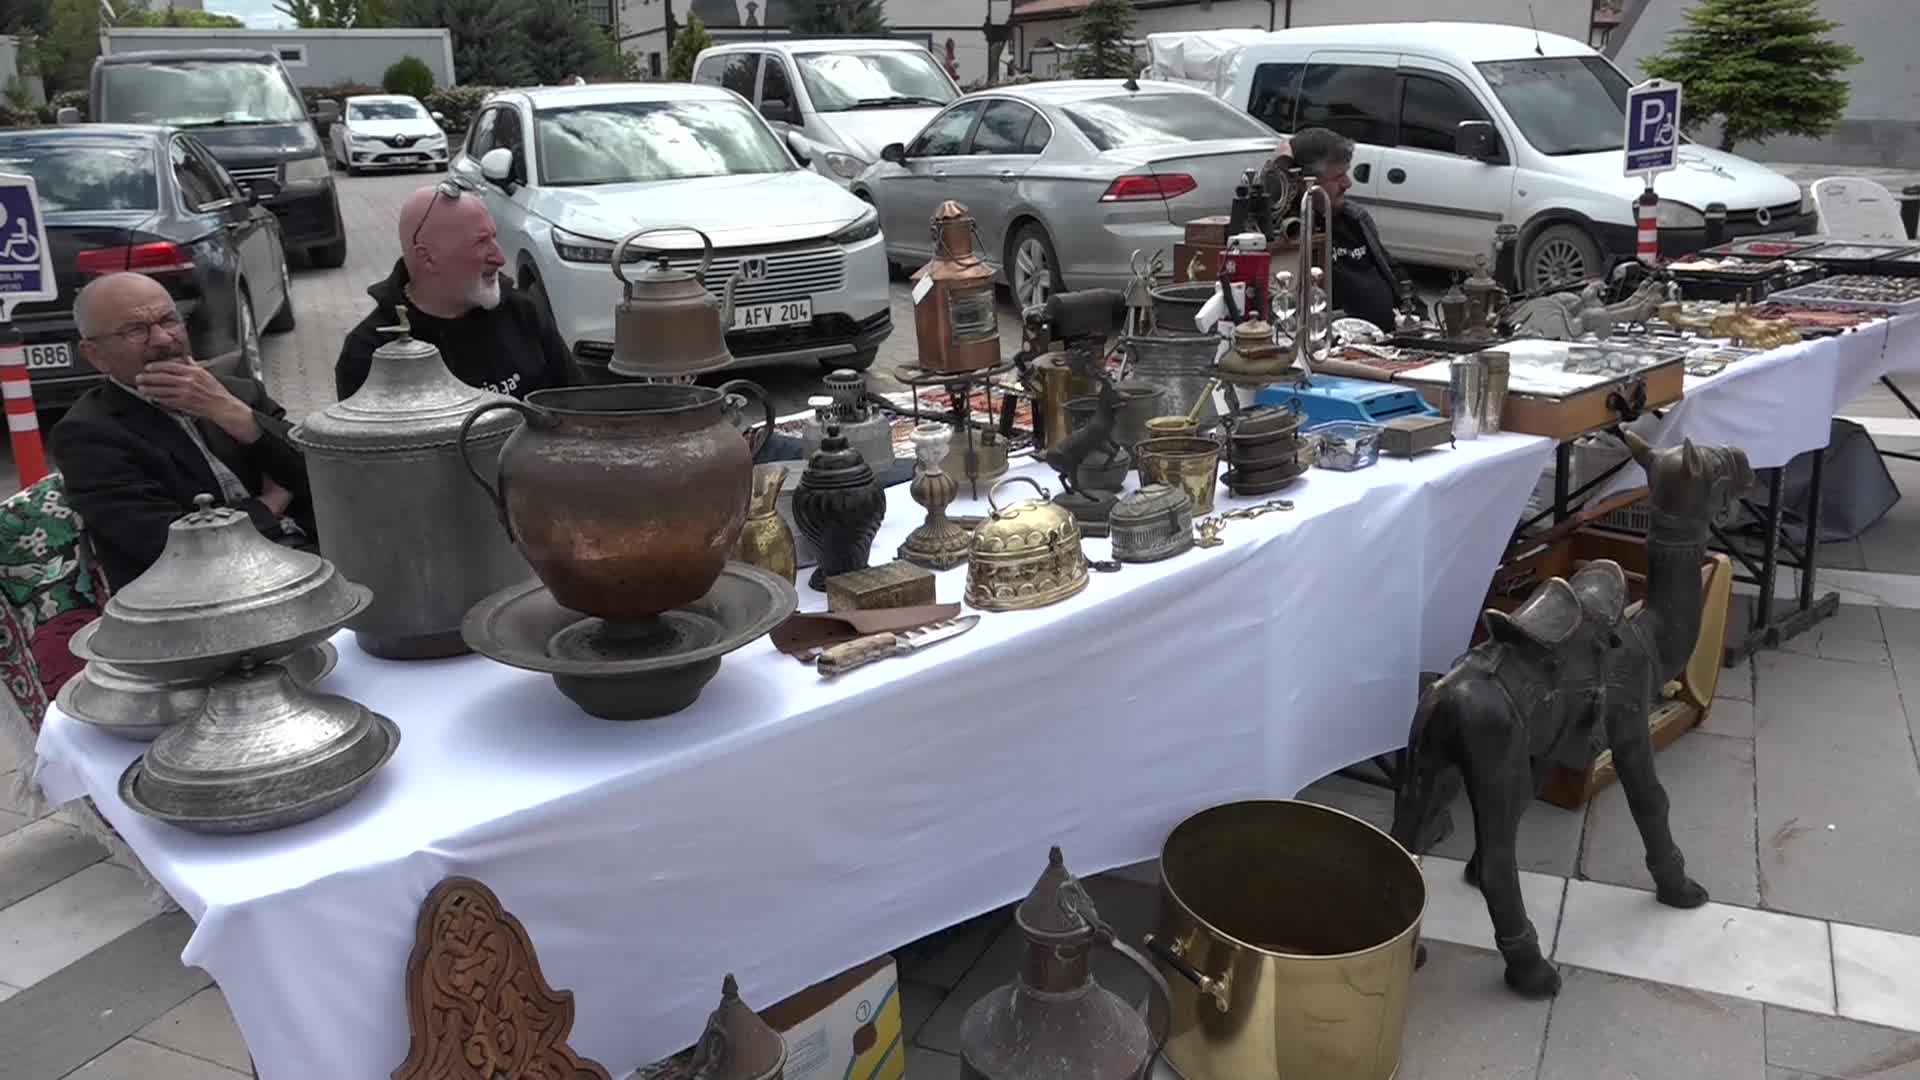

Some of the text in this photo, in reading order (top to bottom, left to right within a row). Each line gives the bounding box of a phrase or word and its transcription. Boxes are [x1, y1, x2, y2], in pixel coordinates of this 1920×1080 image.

[1639, 98, 1665, 142] P
[745, 304, 808, 326] AFV 204
